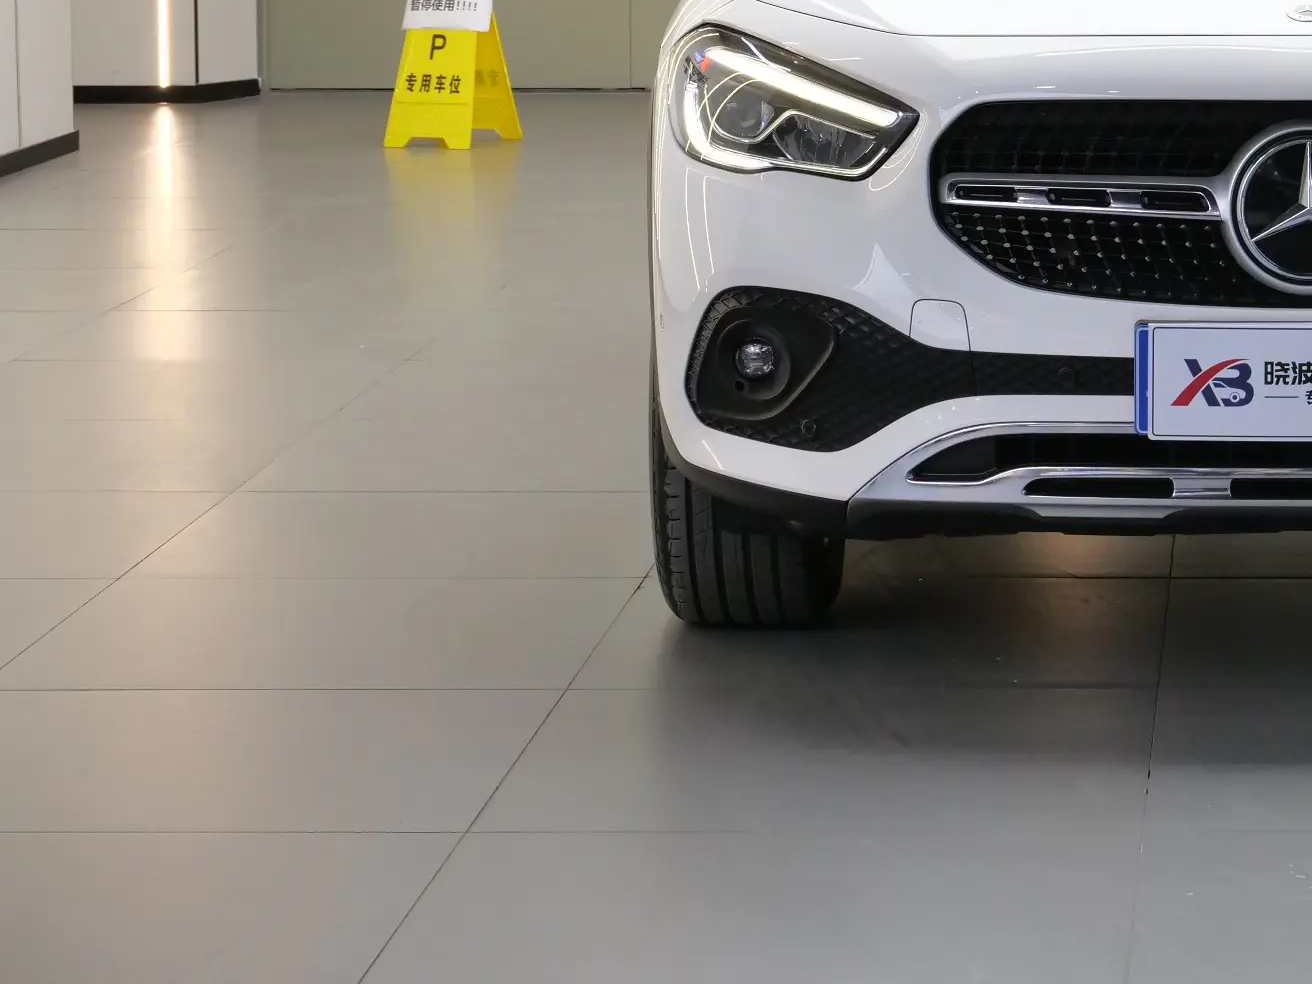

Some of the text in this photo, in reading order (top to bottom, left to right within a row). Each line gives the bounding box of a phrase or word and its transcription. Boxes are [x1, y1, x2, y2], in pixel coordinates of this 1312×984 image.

[429, 34, 447, 60] P
[405, 74, 462, 94] 专用车位
